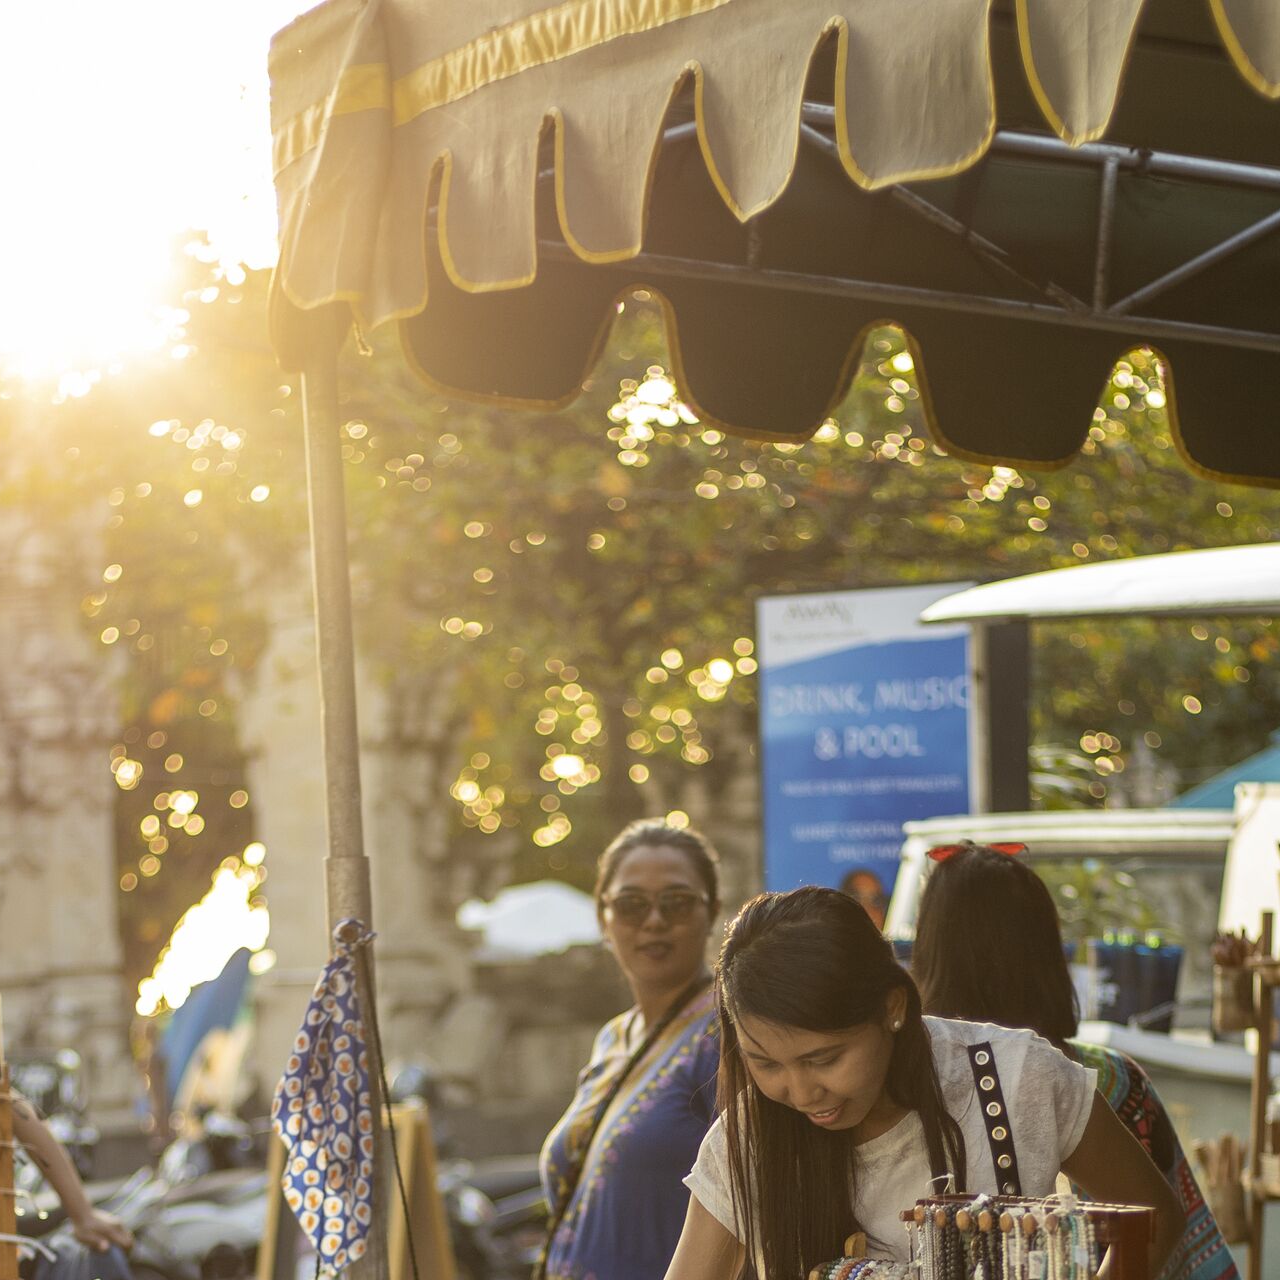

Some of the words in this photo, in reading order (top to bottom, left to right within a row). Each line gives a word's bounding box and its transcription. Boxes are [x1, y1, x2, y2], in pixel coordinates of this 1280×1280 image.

[873, 675, 971, 712] MUSIC
[814, 727, 840, 760] &
[844, 723, 924, 758] POOL
